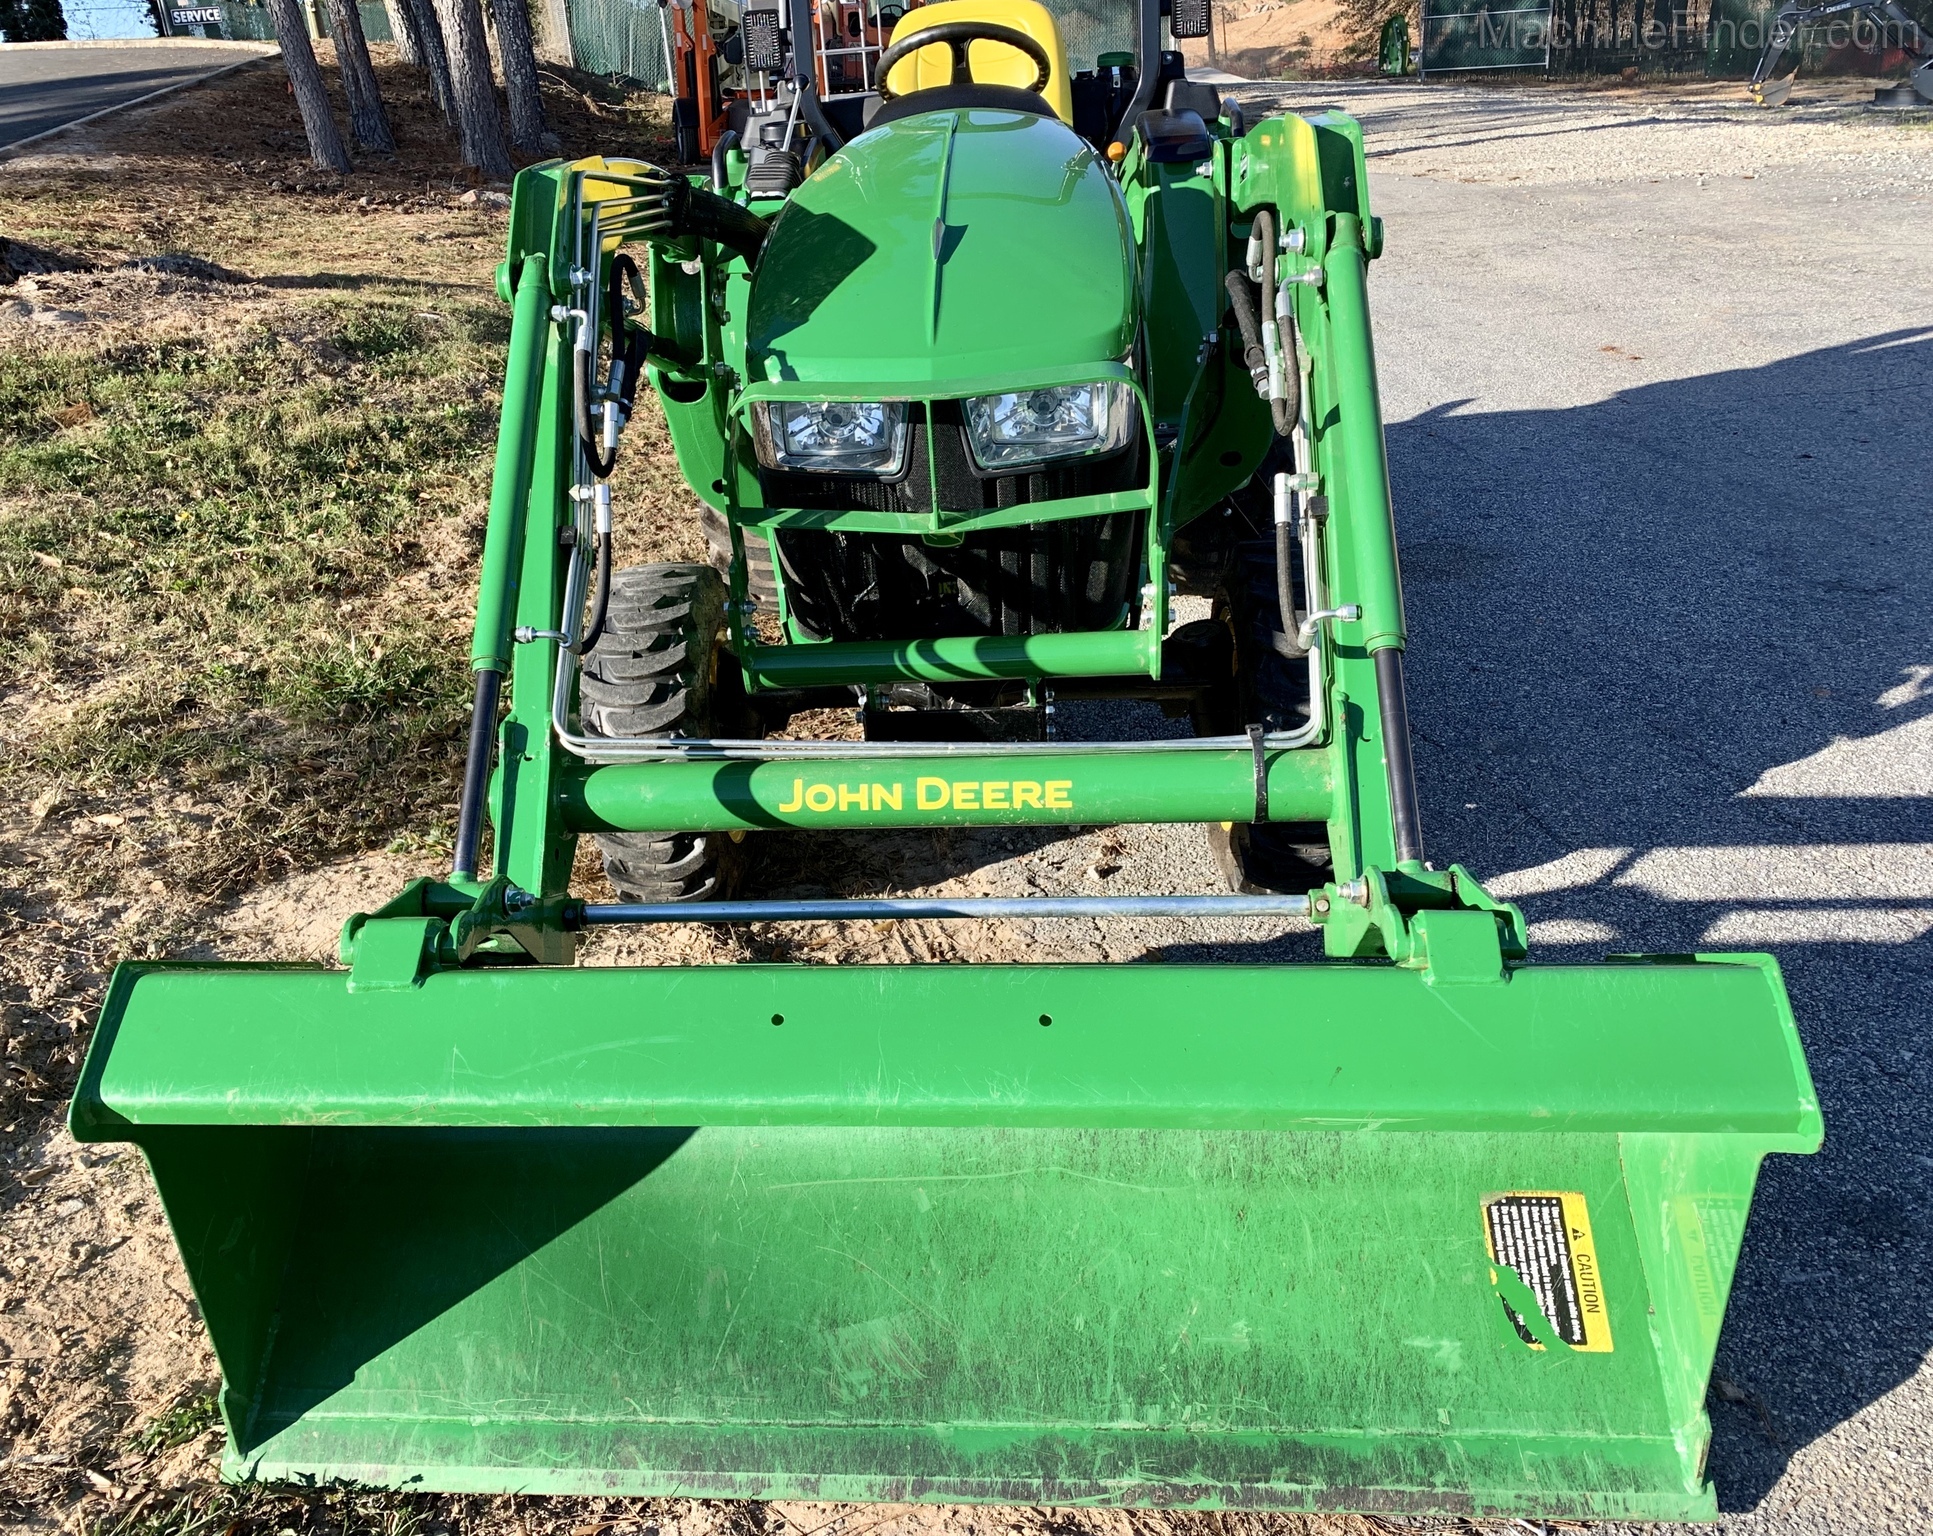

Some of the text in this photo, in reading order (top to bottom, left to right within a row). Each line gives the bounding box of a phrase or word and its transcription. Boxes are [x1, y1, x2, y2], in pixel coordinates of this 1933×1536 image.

[173, 9, 221, 23] SERVICE
[1826, 2, 1852, 13] DEERE
[778, 777, 1073, 812] JOHN DEERE
[1576, 1254, 1601, 1313] CAUTION
